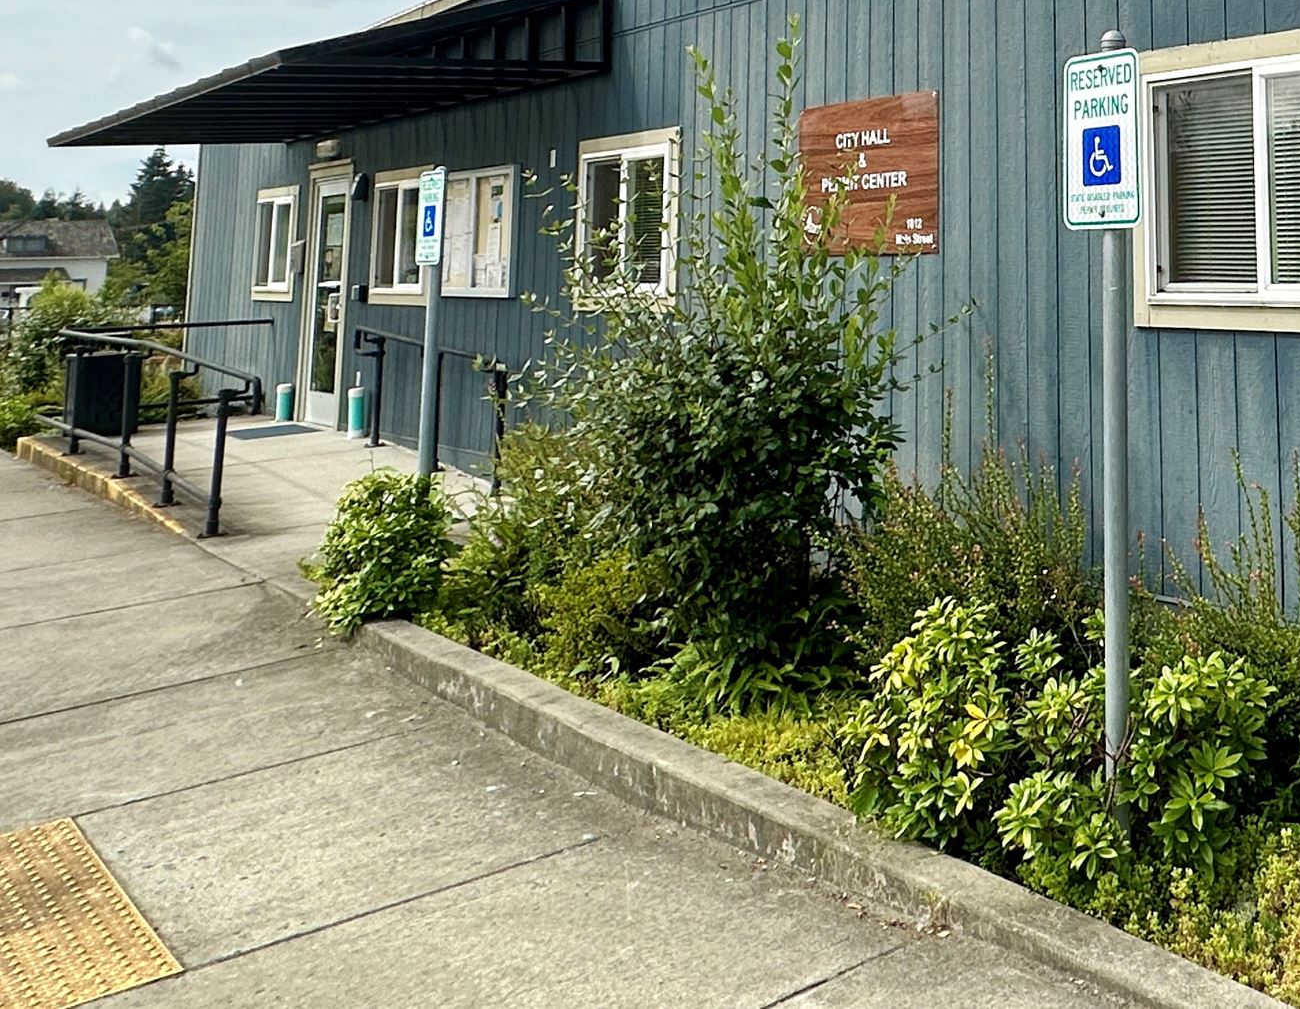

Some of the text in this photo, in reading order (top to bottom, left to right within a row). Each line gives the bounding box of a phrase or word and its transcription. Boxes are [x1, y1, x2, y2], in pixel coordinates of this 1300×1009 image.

[1070, 63, 1132, 92] RESERVED
[1074, 93, 1129, 120] PARKING
[835, 128, 891, 149] CITY HALL
[858, 152, 867, 168] &
[861, 170, 908, 190] CENTER
